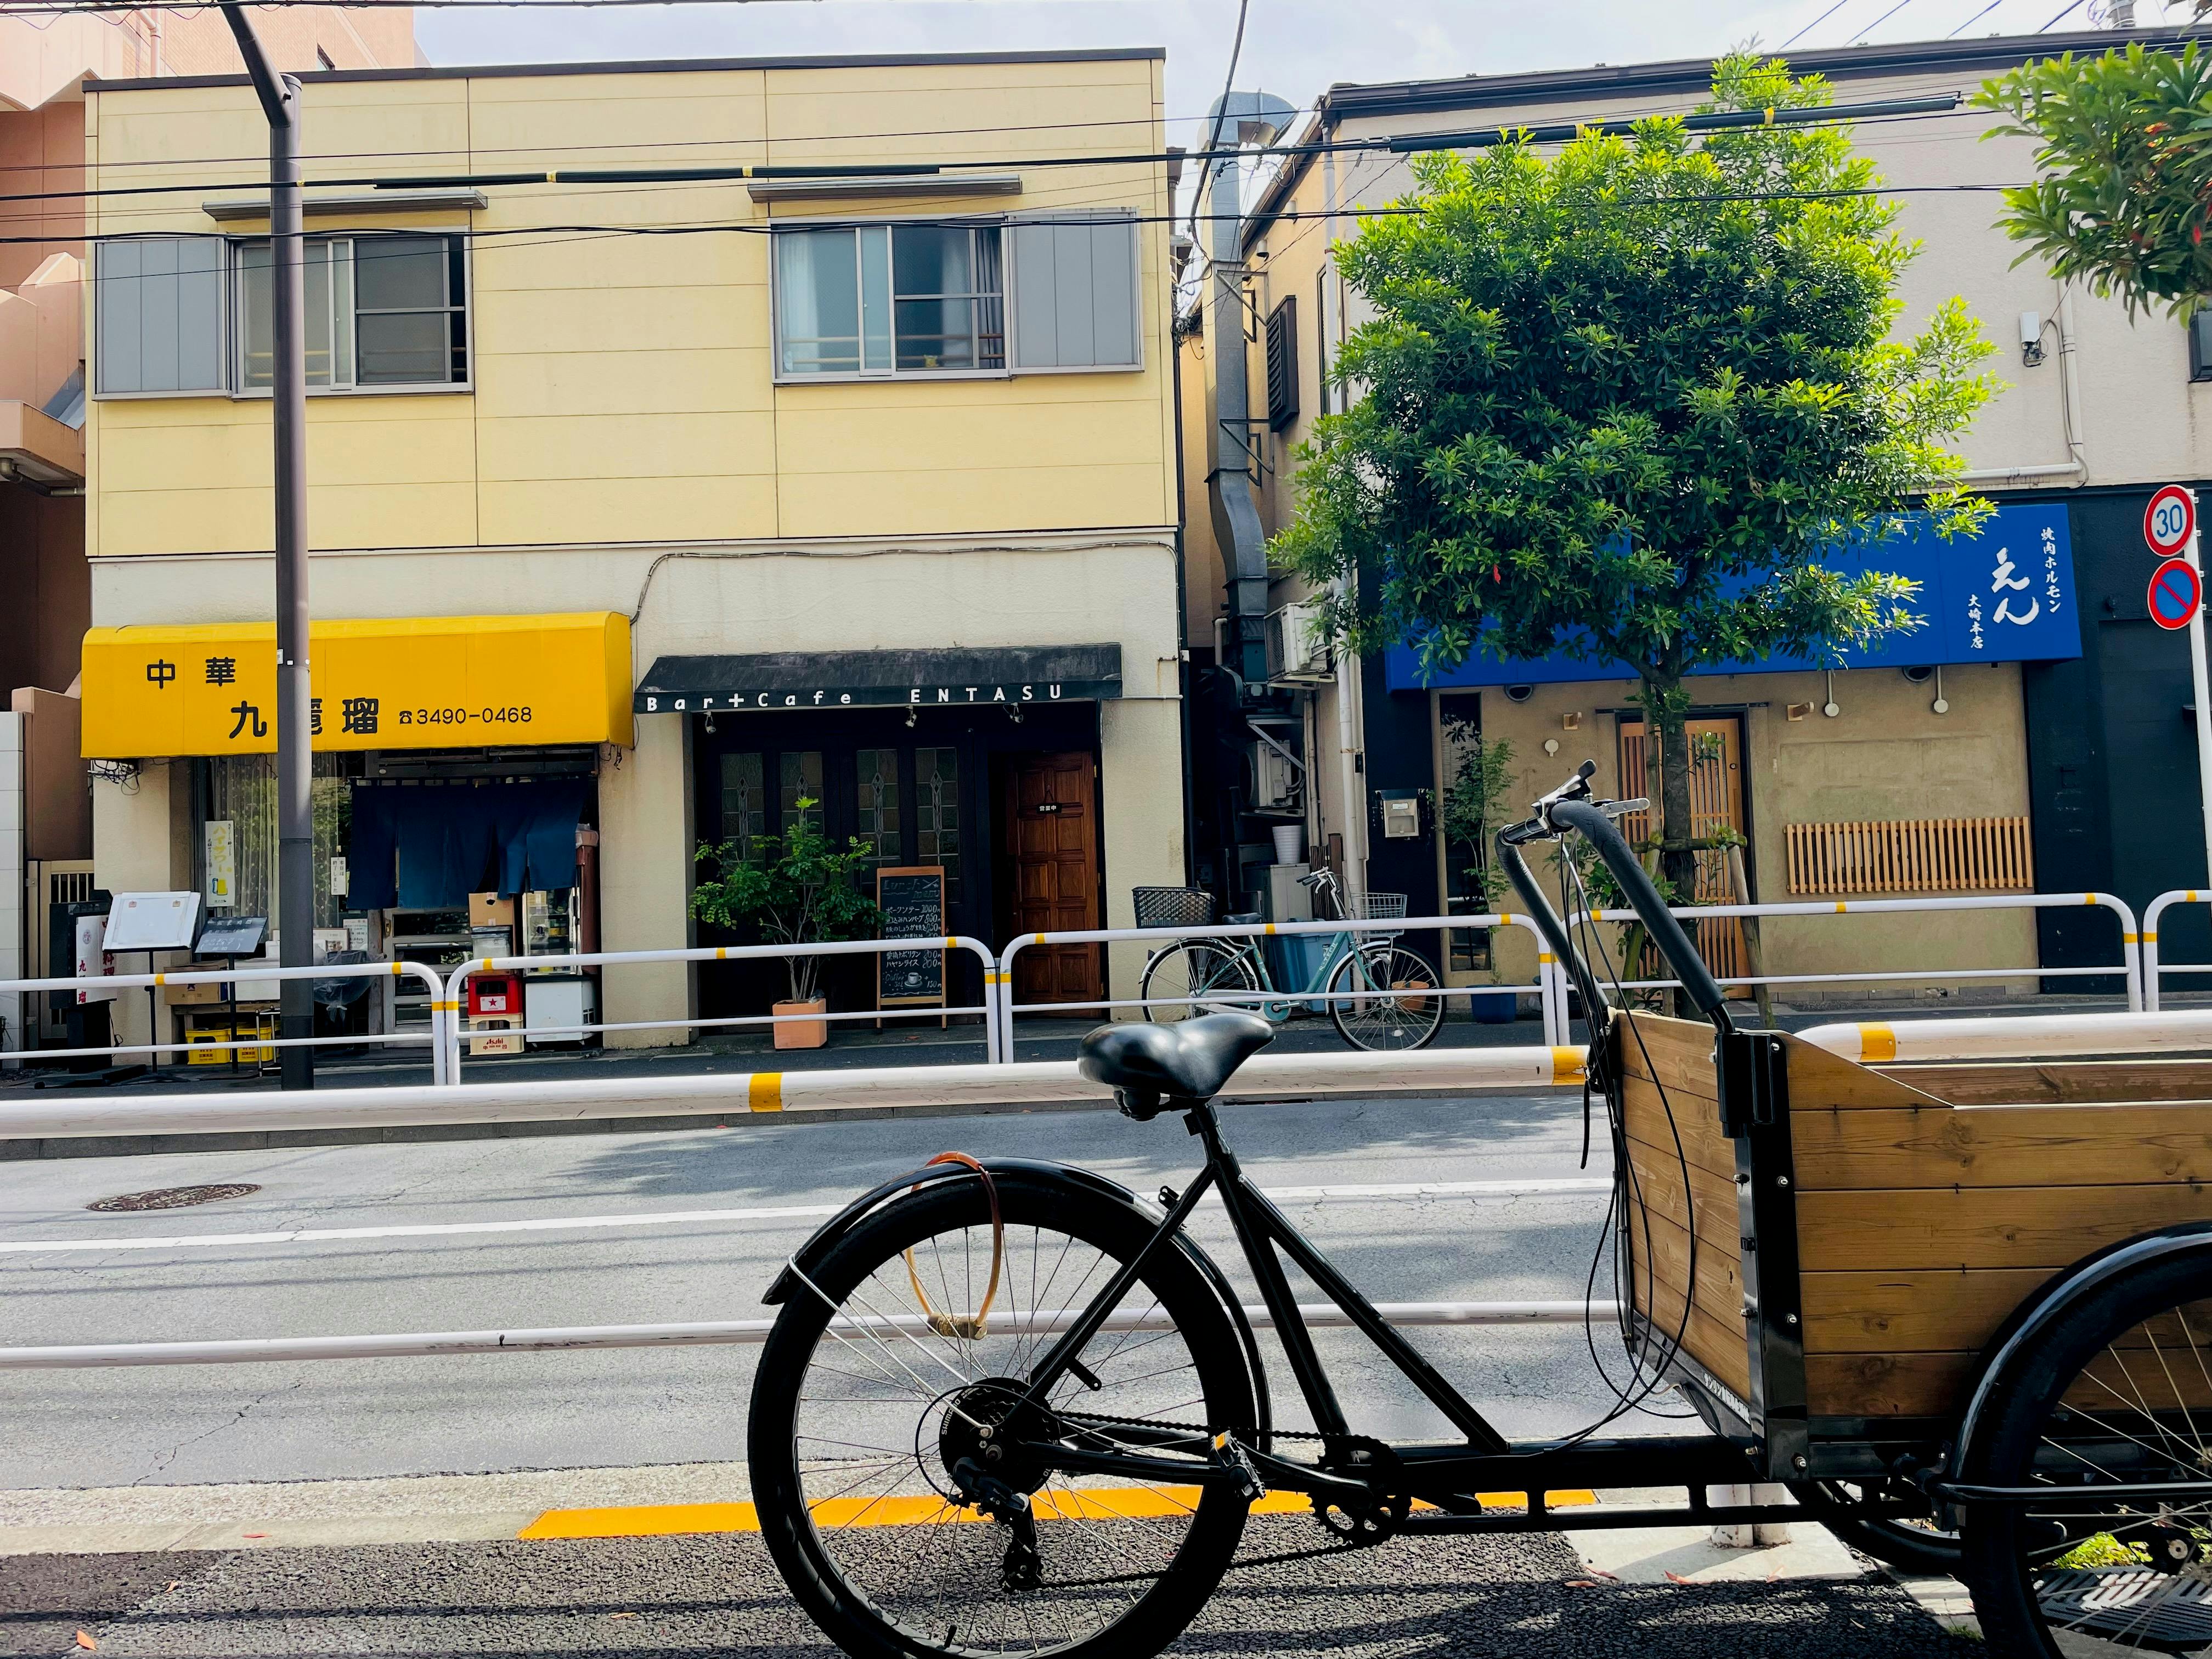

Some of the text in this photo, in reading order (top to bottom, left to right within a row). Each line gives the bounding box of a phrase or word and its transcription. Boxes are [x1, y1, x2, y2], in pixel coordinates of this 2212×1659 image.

[2156, 504, 2183, 538] 30
[1991, 547, 2039, 625] えん
[910, 684, 1062, 704] ENTASU
